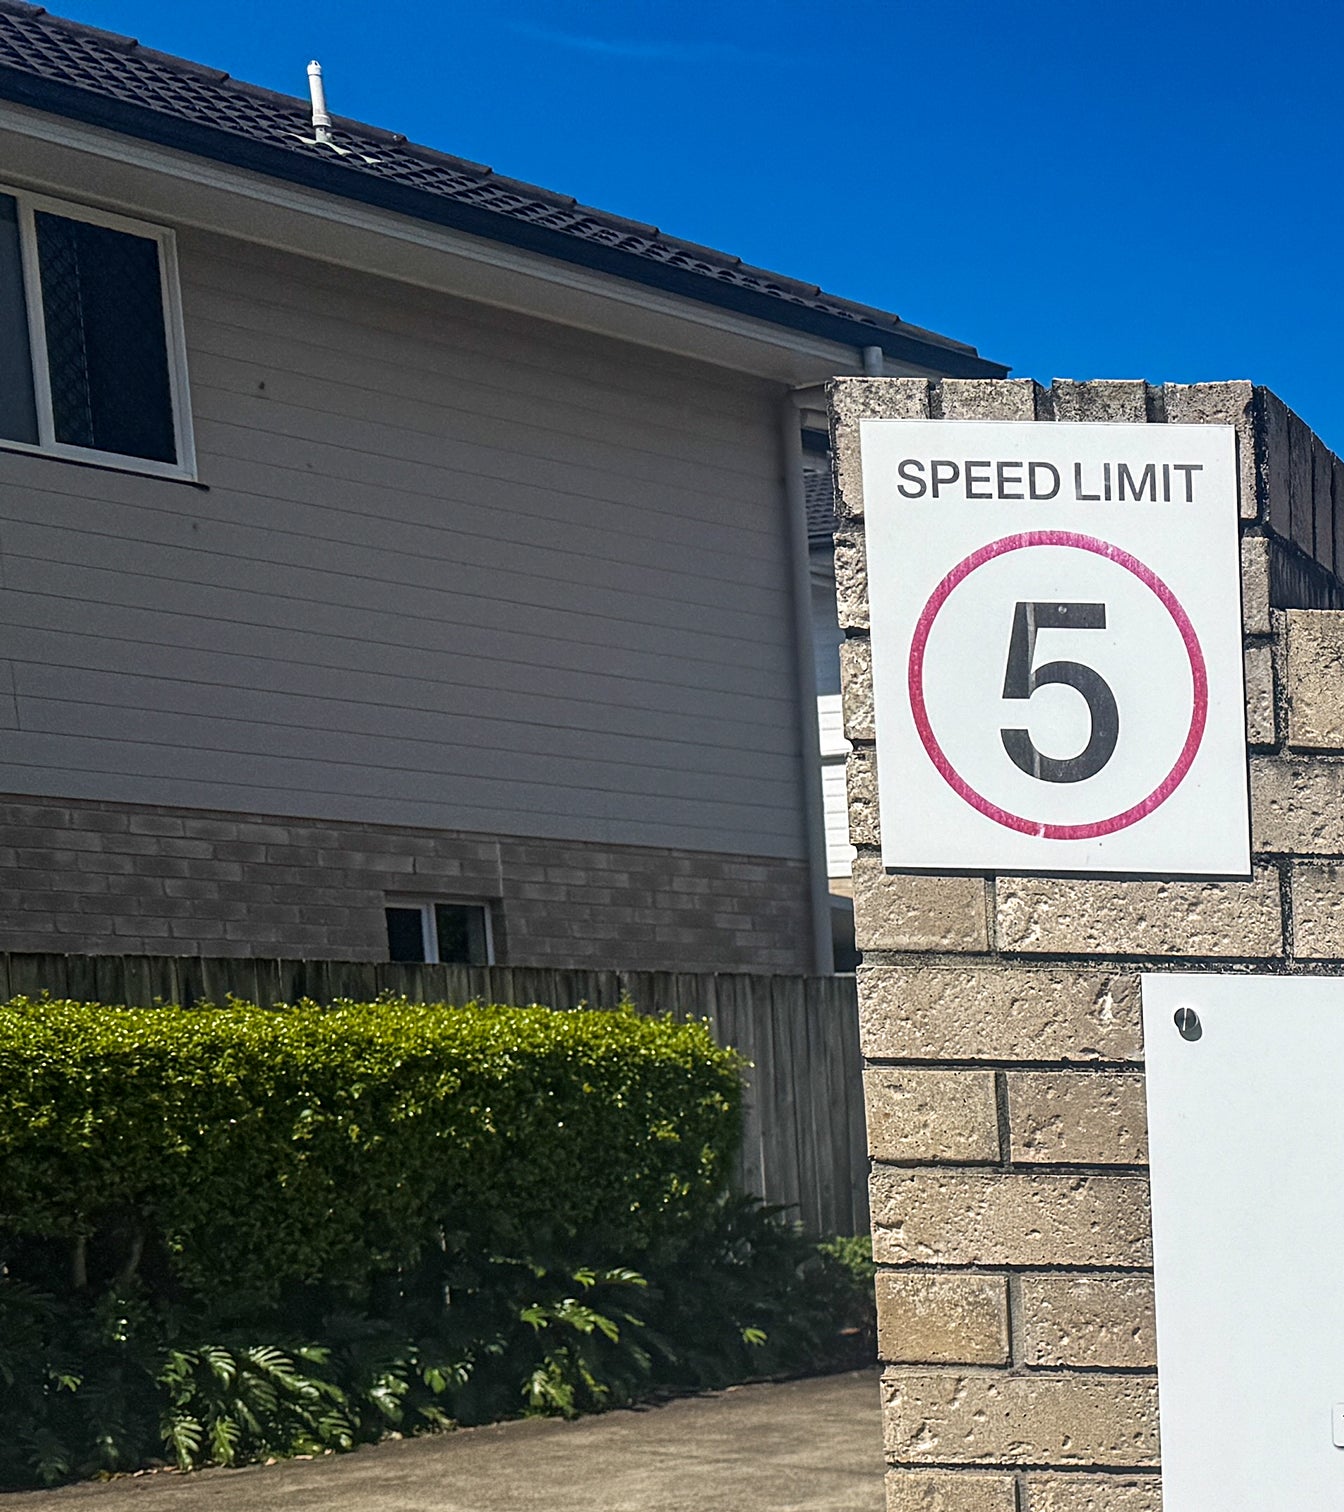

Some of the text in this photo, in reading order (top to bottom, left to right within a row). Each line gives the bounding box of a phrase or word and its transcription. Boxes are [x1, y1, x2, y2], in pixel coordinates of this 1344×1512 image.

[898, 460, 1203, 502] SPEED LIMIT
[1001, 602, 1119, 783] 5
